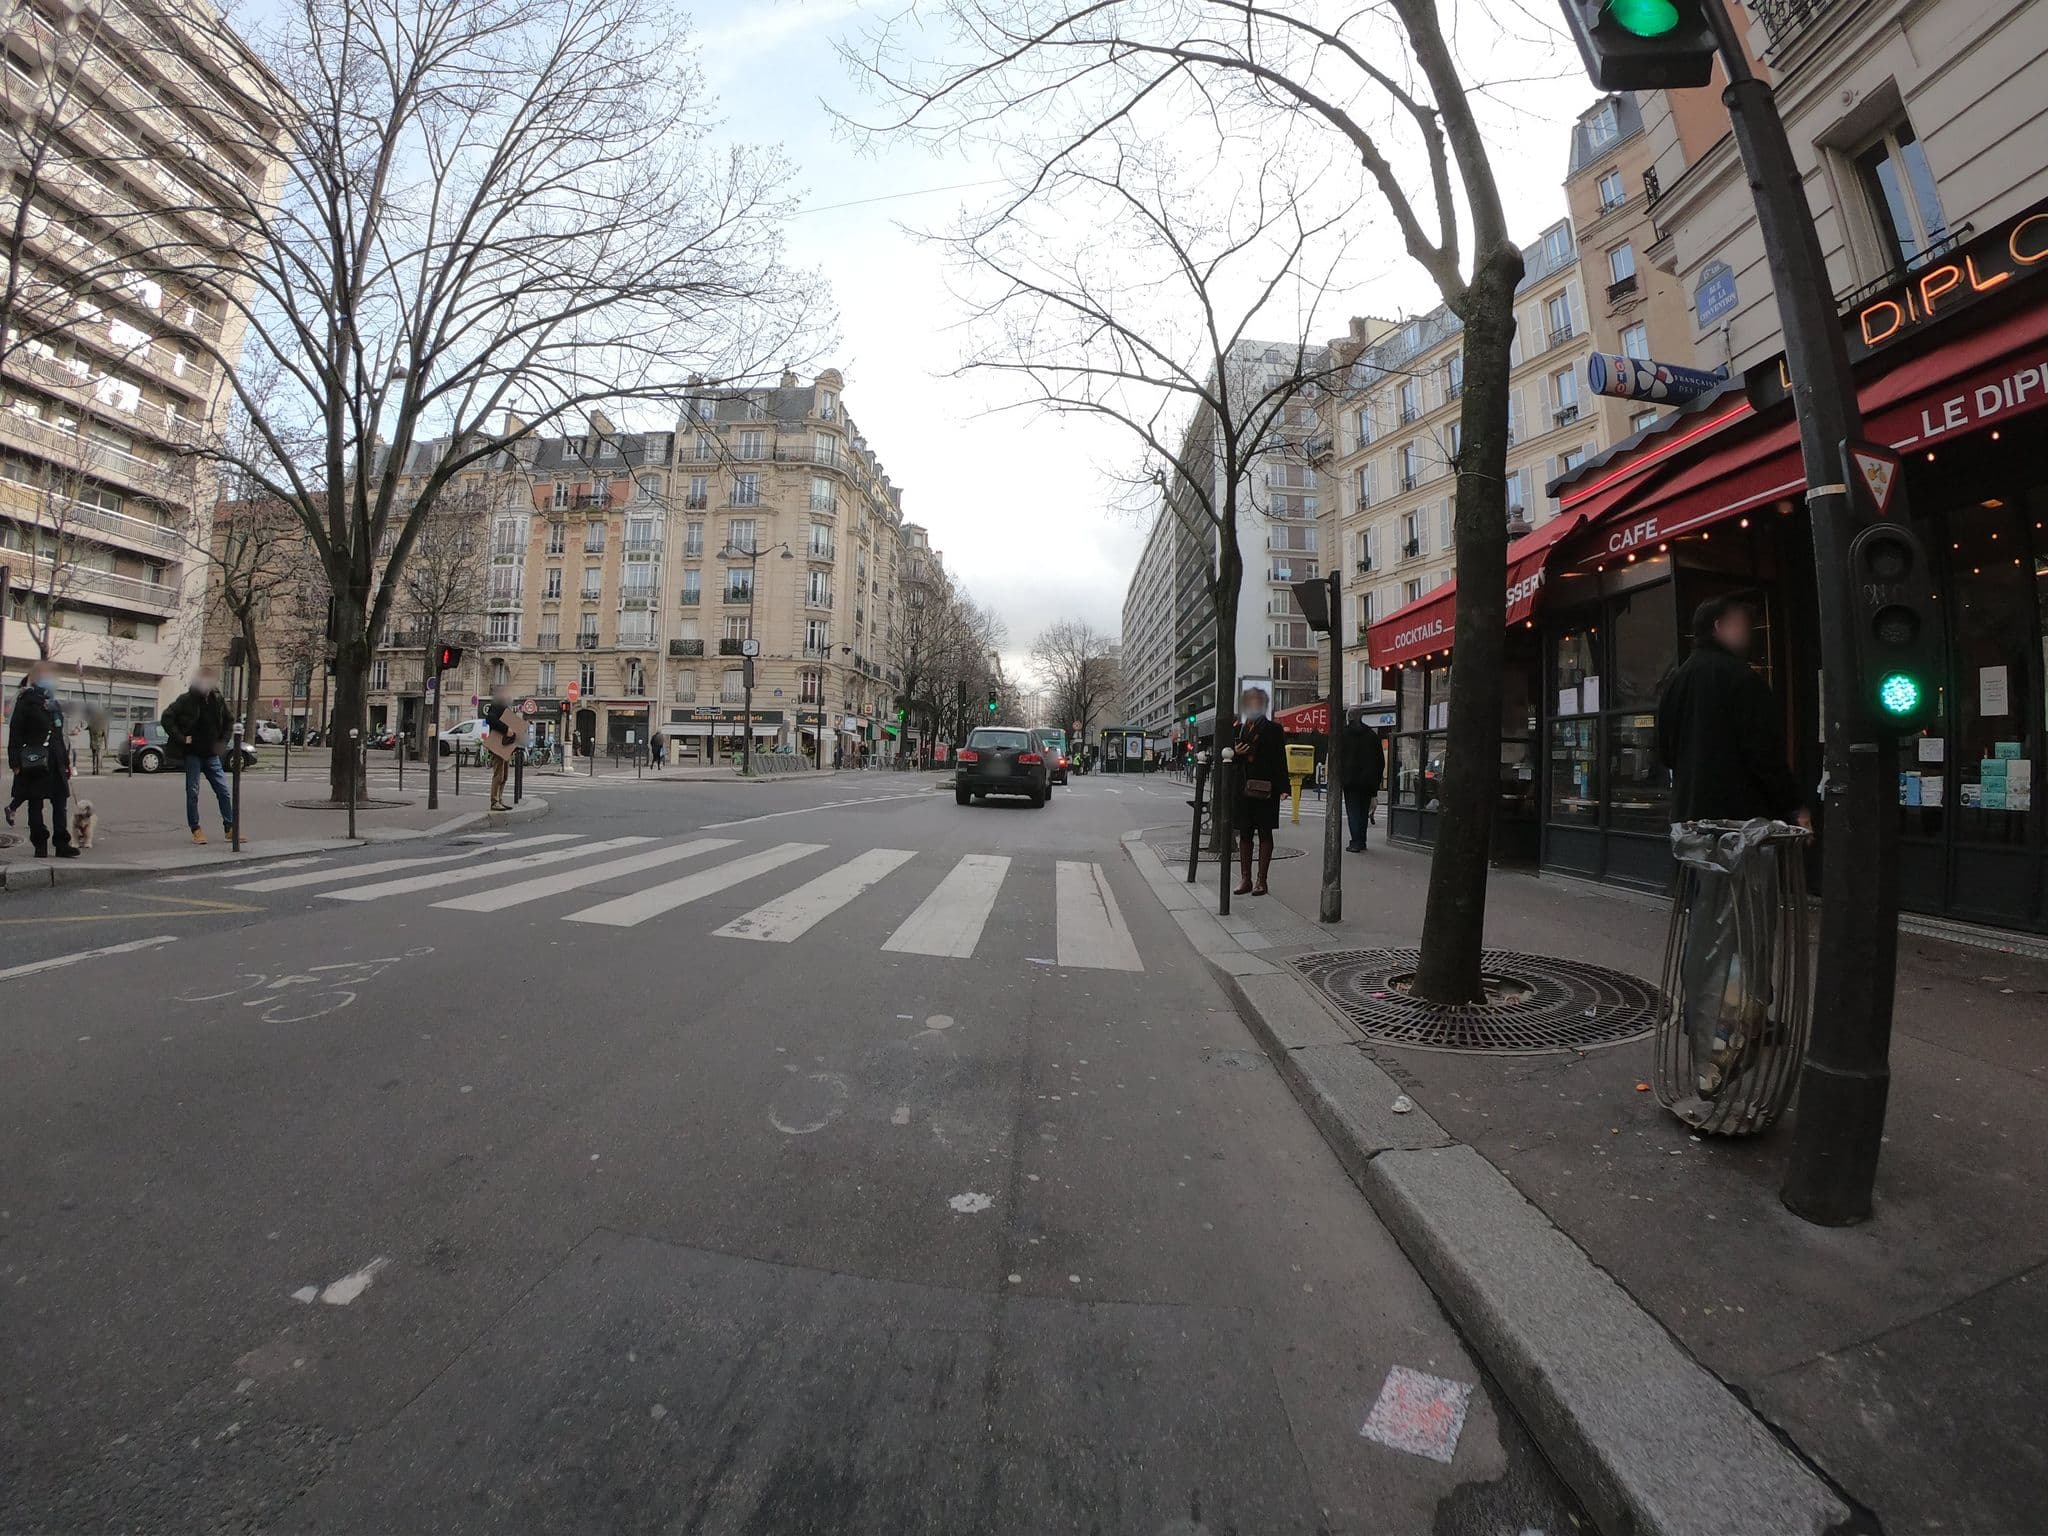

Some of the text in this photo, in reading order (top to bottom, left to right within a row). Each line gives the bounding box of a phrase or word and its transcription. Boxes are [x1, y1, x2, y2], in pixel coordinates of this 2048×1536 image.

[1921, 395, 1969, 438] LE
[1608, 517, 1658, 552] CAFE
[1394, 619, 1443, 649] COCKTAILS
[1295, 709, 1327, 725] CAFE
